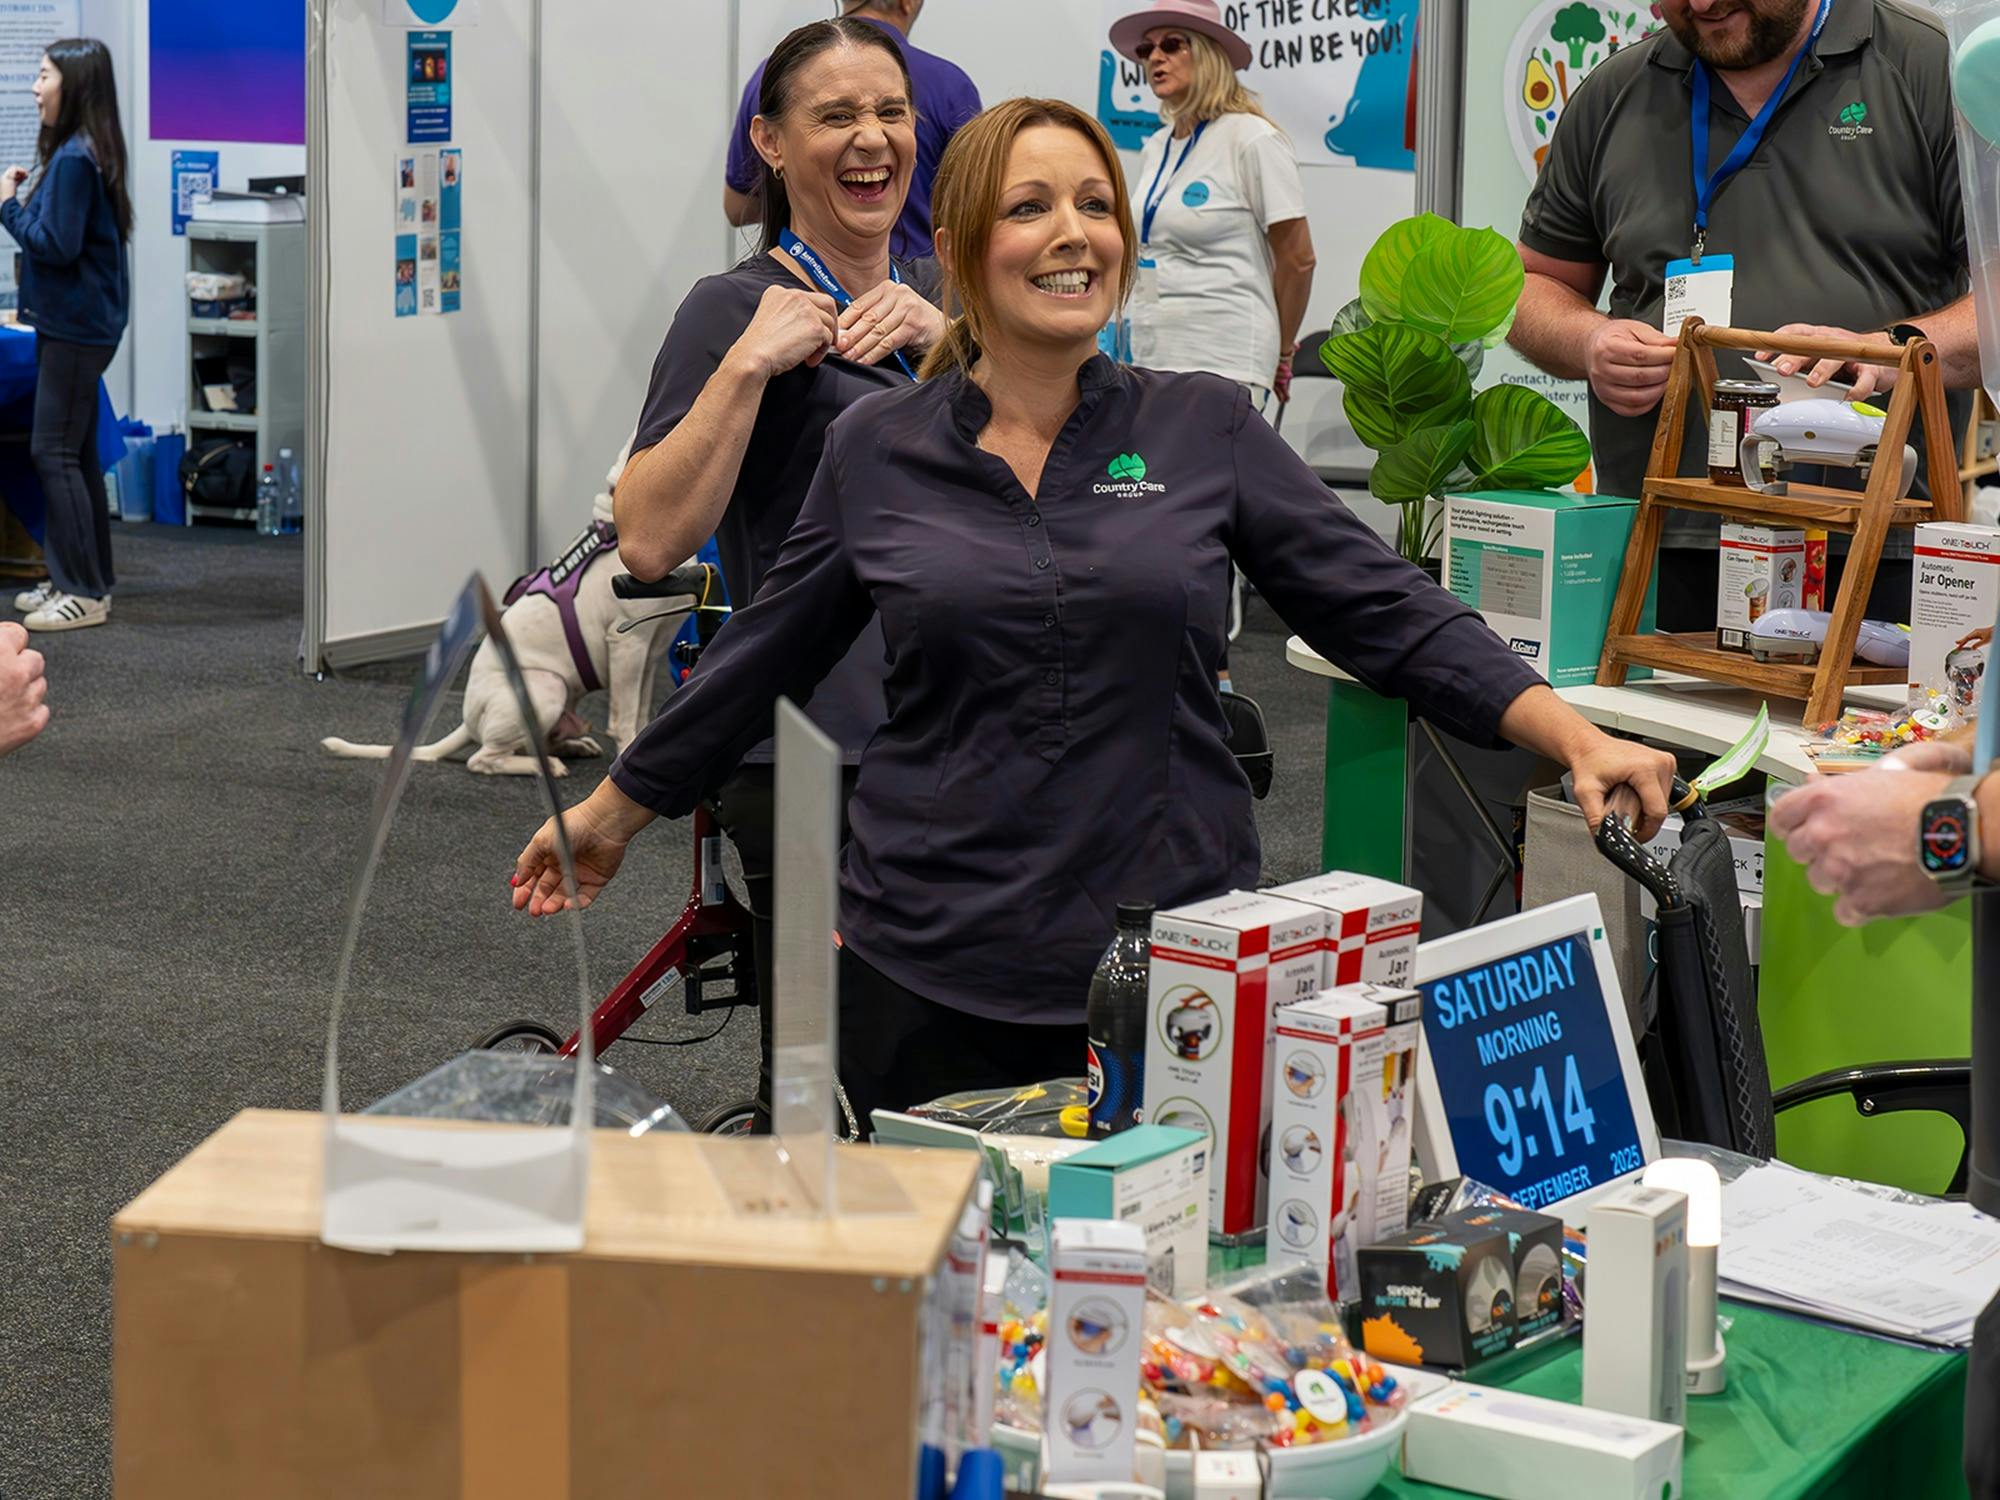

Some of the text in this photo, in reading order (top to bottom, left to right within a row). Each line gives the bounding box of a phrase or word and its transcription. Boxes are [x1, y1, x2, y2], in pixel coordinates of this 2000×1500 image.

[1225, 5, 1250, 31] OF
[1256, 0, 1303, 28] THE
[1260, 36, 1301, 69] CAN
[1310, 32, 1344, 63] BE
[1351, 23, 1403, 57] YOU!
[1827, 125, 1873, 136] Country Care
[1500, 373, 1547, 385] Contact
[1093, 481, 1166, 494] Country Care
[1921, 561, 1955, 573] Automatic
[1920, 571, 1976, 590] Jar Opener
[1512, 641, 1537, 655] KCare
[1388, 959, 1409, 976] Jar
[1295, 978, 1315, 996] Jar
[1434, 941, 1577, 1029] SATURDAY
[1475, 1010, 1563, 1067] MORNING
[1483, 1053, 1596, 1177] 9:14
[1609, 1144, 1643, 1176] 2025
